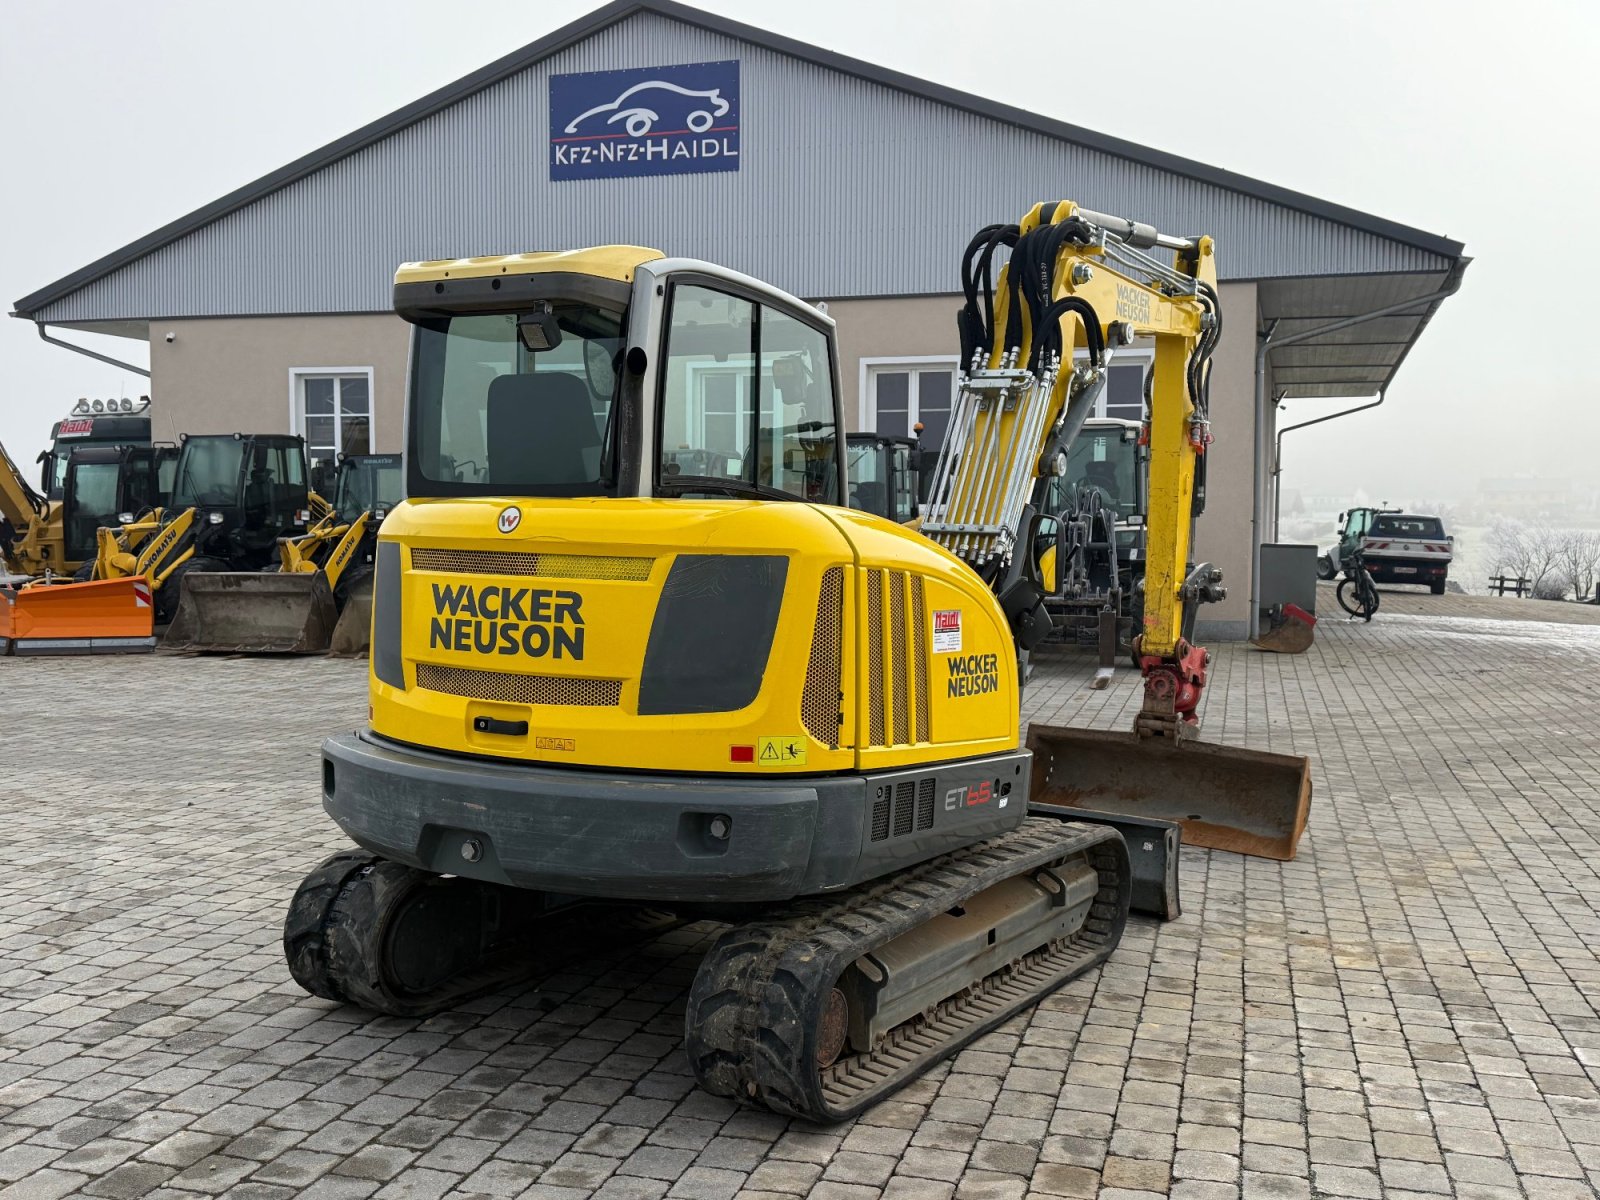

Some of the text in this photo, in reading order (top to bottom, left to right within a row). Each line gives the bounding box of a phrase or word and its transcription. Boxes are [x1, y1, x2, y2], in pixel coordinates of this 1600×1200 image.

[1115, 282, 1150, 308] WACKER
[1115, 301, 1150, 325] NEUSON
[144, 529, 177, 568] KOMATSU
[335, 535, 355, 567] KOMATSU
[431, 583, 586, 625] WACKER
[430, 617, 585, 661] NEUSON
[947, 653, 998, 677] WACKER
[947, 672, 998, 699] NEUSON
[945, 781, 991, 811] ET65
